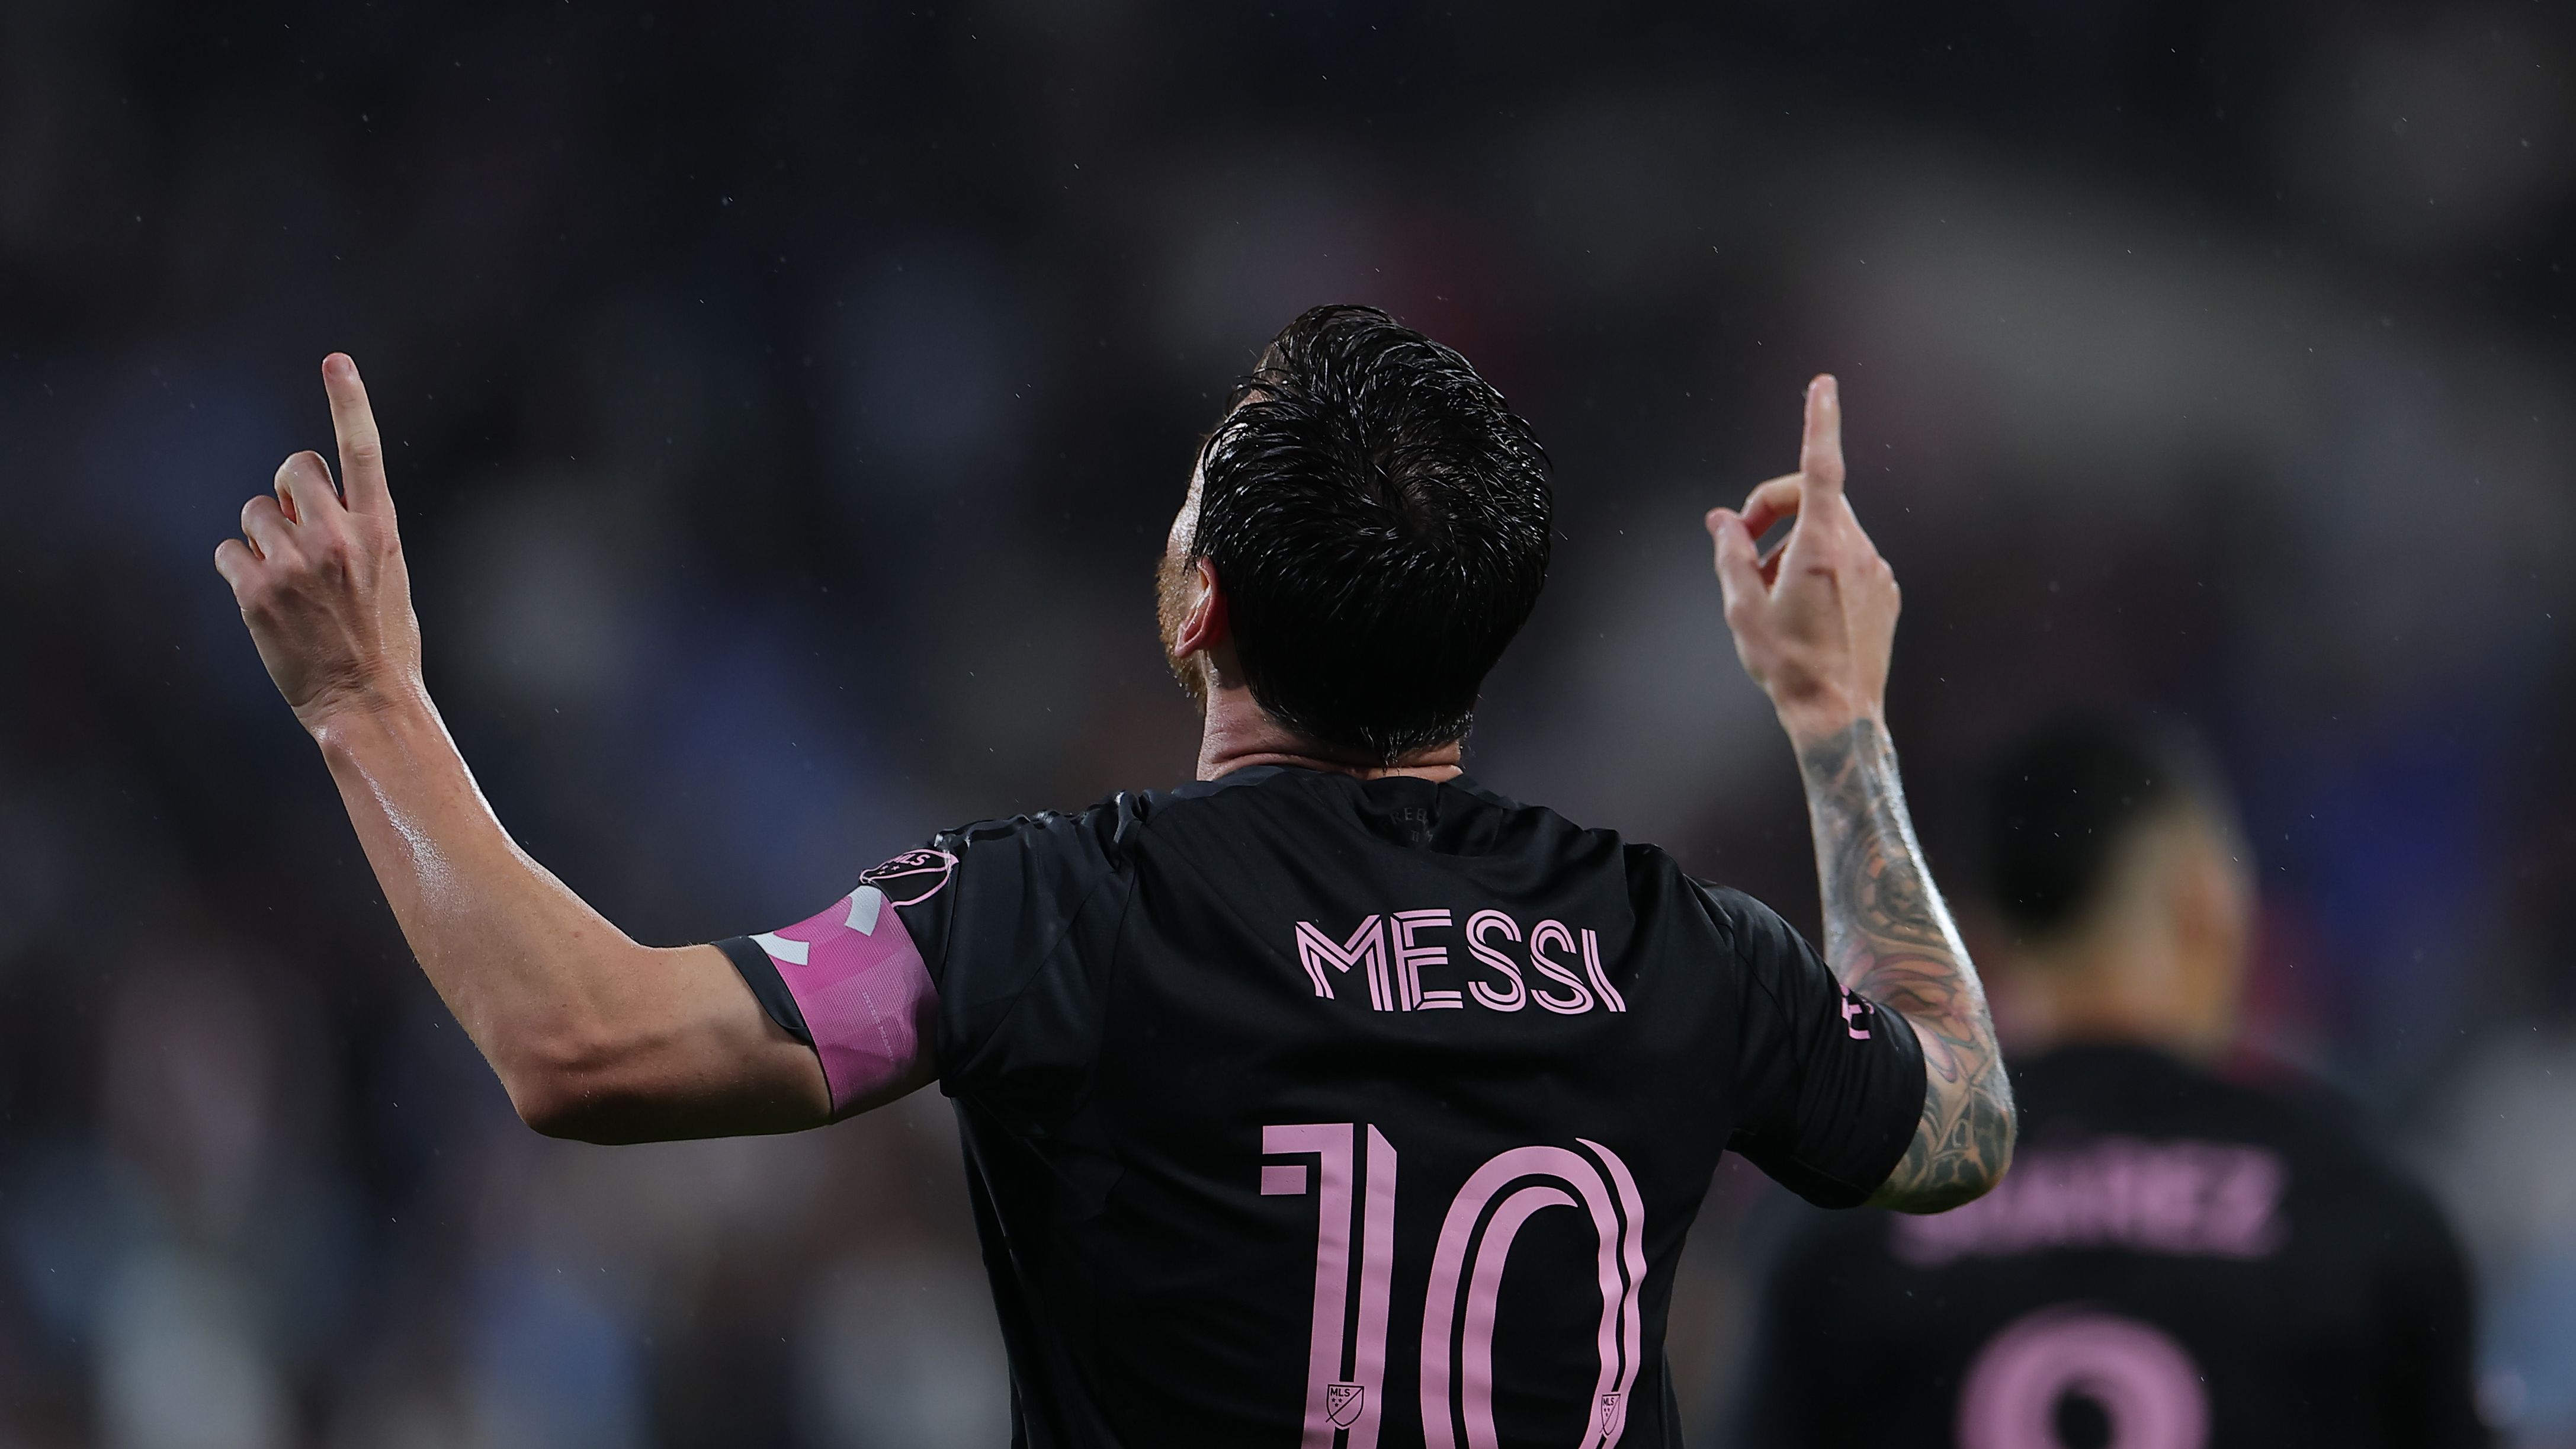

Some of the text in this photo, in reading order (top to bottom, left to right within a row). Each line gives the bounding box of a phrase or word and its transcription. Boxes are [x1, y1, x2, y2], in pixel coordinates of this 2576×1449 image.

[1295, 909, 1626, 1014] MESSI
[1261, 1123, 1647, 1449] 10
[1330, 1387, 1350, 1397] MLS
[1603, 1397, 1615, 1406] MLS
